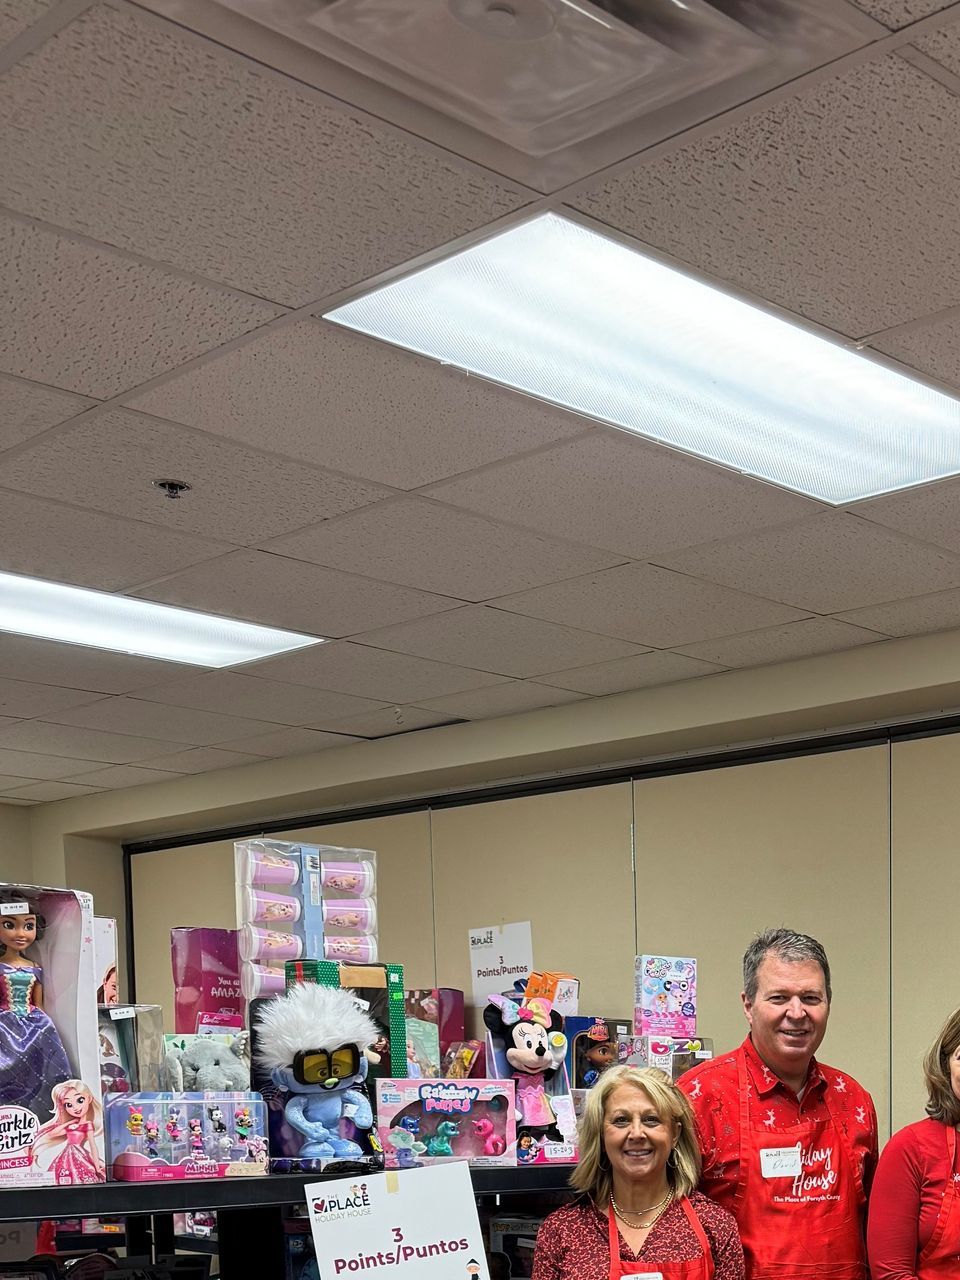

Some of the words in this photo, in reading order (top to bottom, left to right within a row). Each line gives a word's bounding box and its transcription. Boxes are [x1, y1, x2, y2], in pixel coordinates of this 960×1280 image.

[499, 956, 504, 965] 3
[477, 965, 528, 978] Points/Puntos
[218, 977, 232, 986] You
[381, 1093, 389, 1104] 3
[185, 1163, 219, 1174] MINNIE
[792, 1170, 838, 1197] House
[327, 1194, 371, 1213] PLACE
[314, 1213, 346, 1224] HOLIDAY
[346, 1208, 373, 1219] HOUSE
[391, 1227, 404, 1243] 3
[333, 1237, 469, 1275] Points/Puntos
